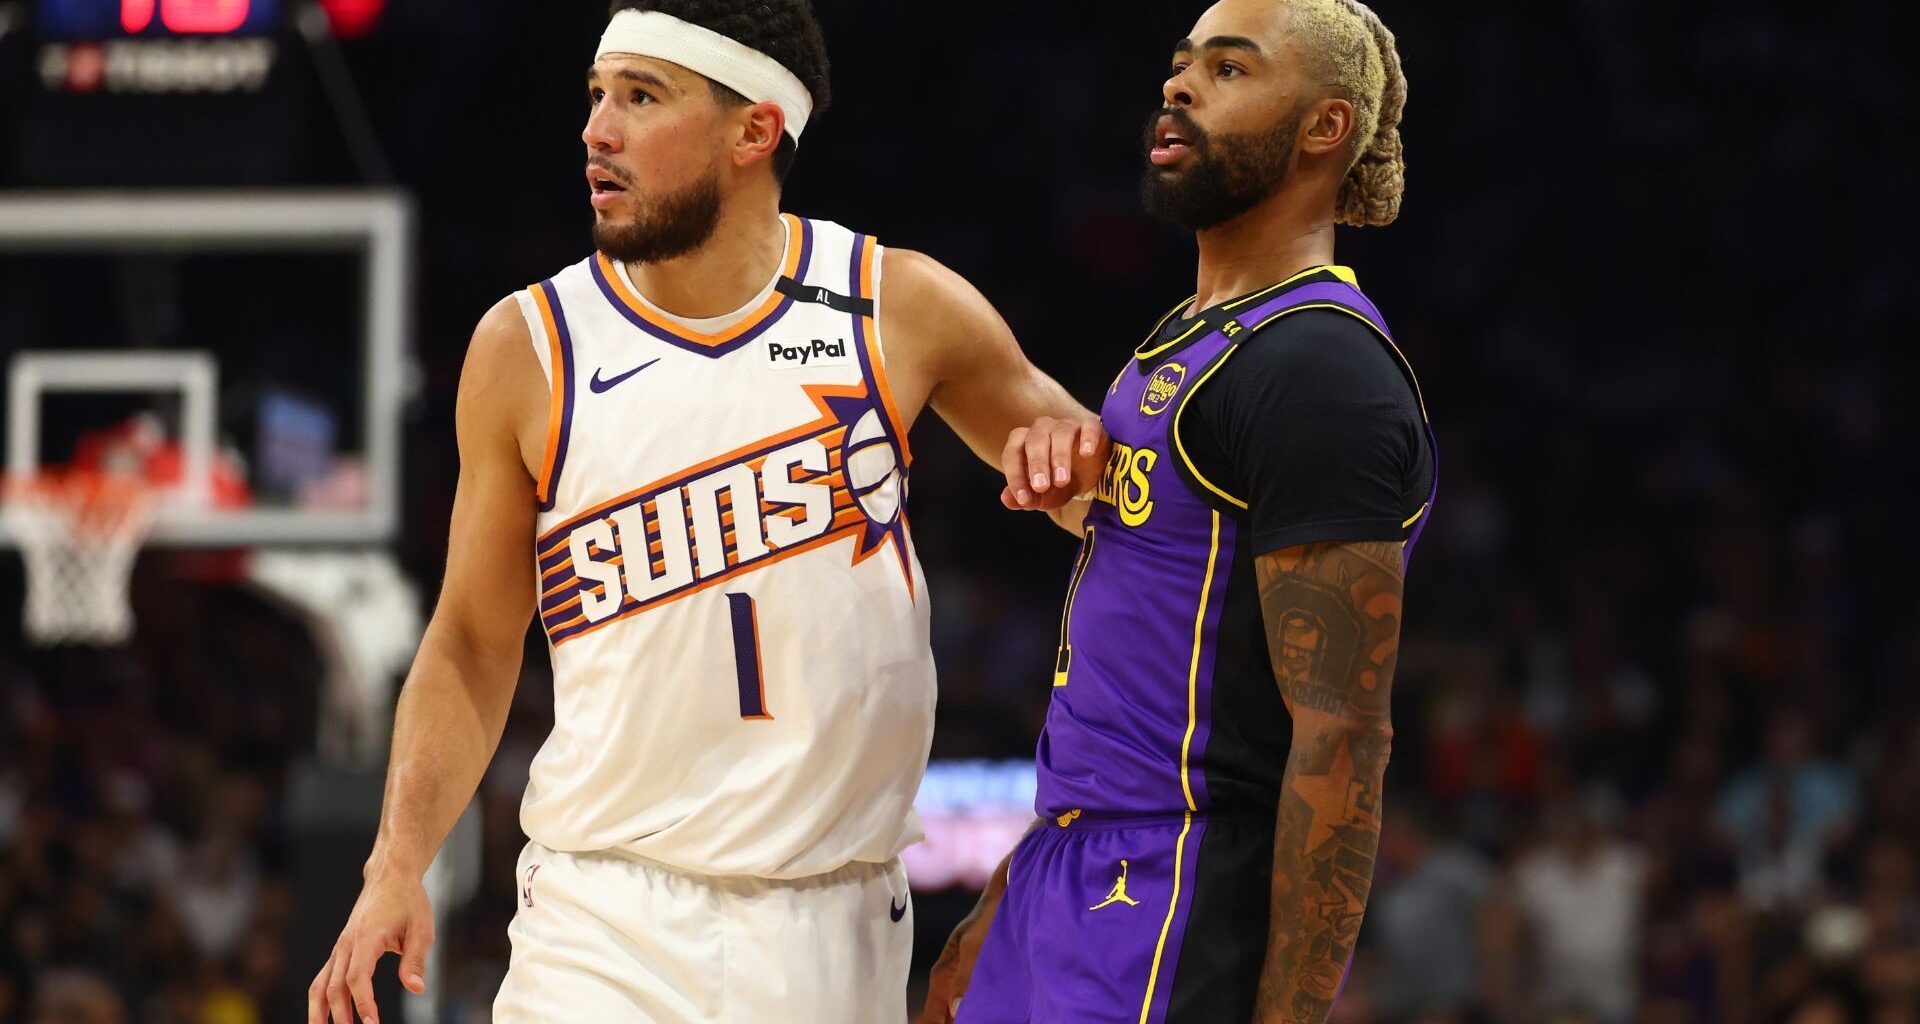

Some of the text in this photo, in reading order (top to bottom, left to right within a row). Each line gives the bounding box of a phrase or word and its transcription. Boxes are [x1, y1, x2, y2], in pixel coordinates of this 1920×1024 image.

[816, 289, 830, 305] AL
[1222, 320, 1242, 337] 44
[768, 338, 846, 365] PayPal
[1149, 375, 1177, 401] bibigo
[1097, 442, 1158, 527] ERS
[568, 437, 834, 624] SUNS
[724, 591, 775, 721] 1
